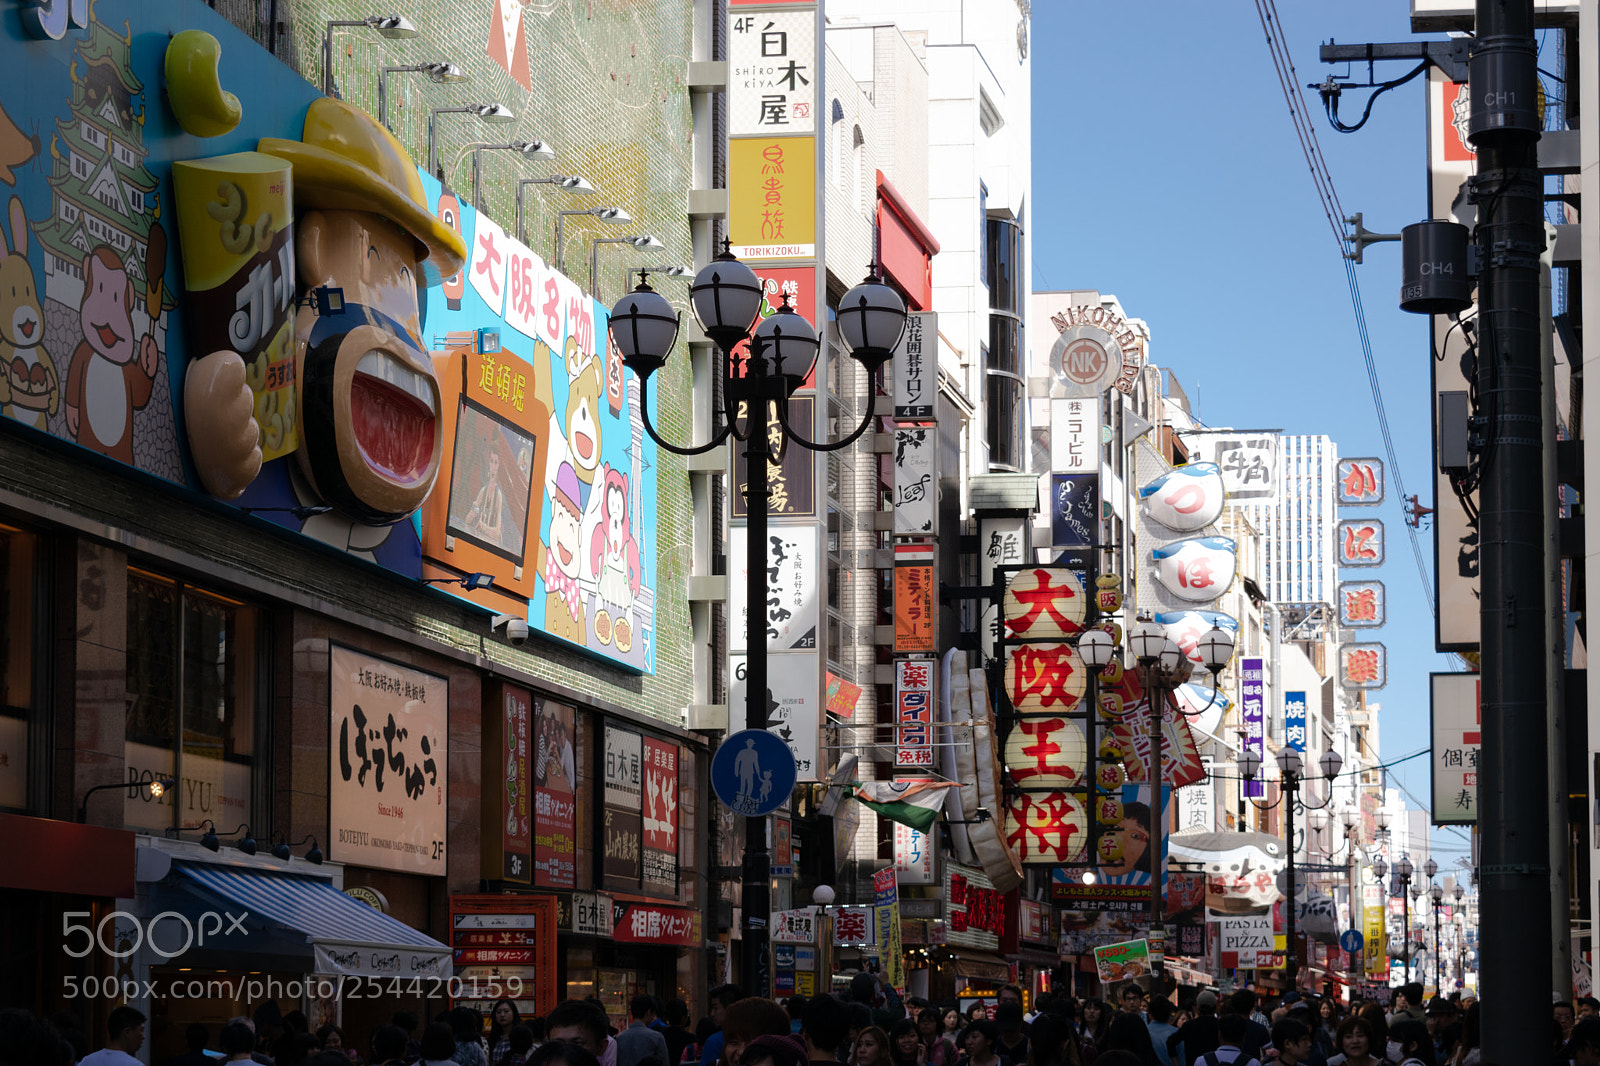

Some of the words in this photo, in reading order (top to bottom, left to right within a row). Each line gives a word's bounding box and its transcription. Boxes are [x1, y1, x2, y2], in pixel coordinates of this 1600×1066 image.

[734, 17, 754, 34] 4F
[758, 21, 810, 125] 白木屋
[1484, 92, 1516, 107] CH1
[743, 245, 801, 257] TORIKIZOKU
[1419, 261, 1454, 276] CH4
[475, 231, 594, 357] 大阪名物
[781, 279, 799, 315] 鉄板
[905, 315, 923, 405] 浪花囲碁サロン
[1070, 351, 1098, 373] NK
[478, 354, 527, 413] 道頓堀
[1222, 450, 1270, 485] 牛角
[895, 473, 932, 508] Leaf
[800, 638, 815, 648] 2F
[902, 661, 930, 689] 薬
[1285, 700, 1306, 745] 焼肉
[606, 742, 640, 785] 白木屋
[897, 750, 932, 765] 免税
[535, 790, 575, 822] 相席ダイニング
[1186, 789, 1208, 826] 焼肉
[1453, 788, 1473, 811] 寿
[431, 840, 445, 861] 2F
[511, 854, 522, 876] 3F
[613, 905, 625, 919] 7F
[631, 908, 694, 939] 相席ダイニング
[836, 908, 866, 941] 薬
[1226, 936, 1271, 949] PIZZA
